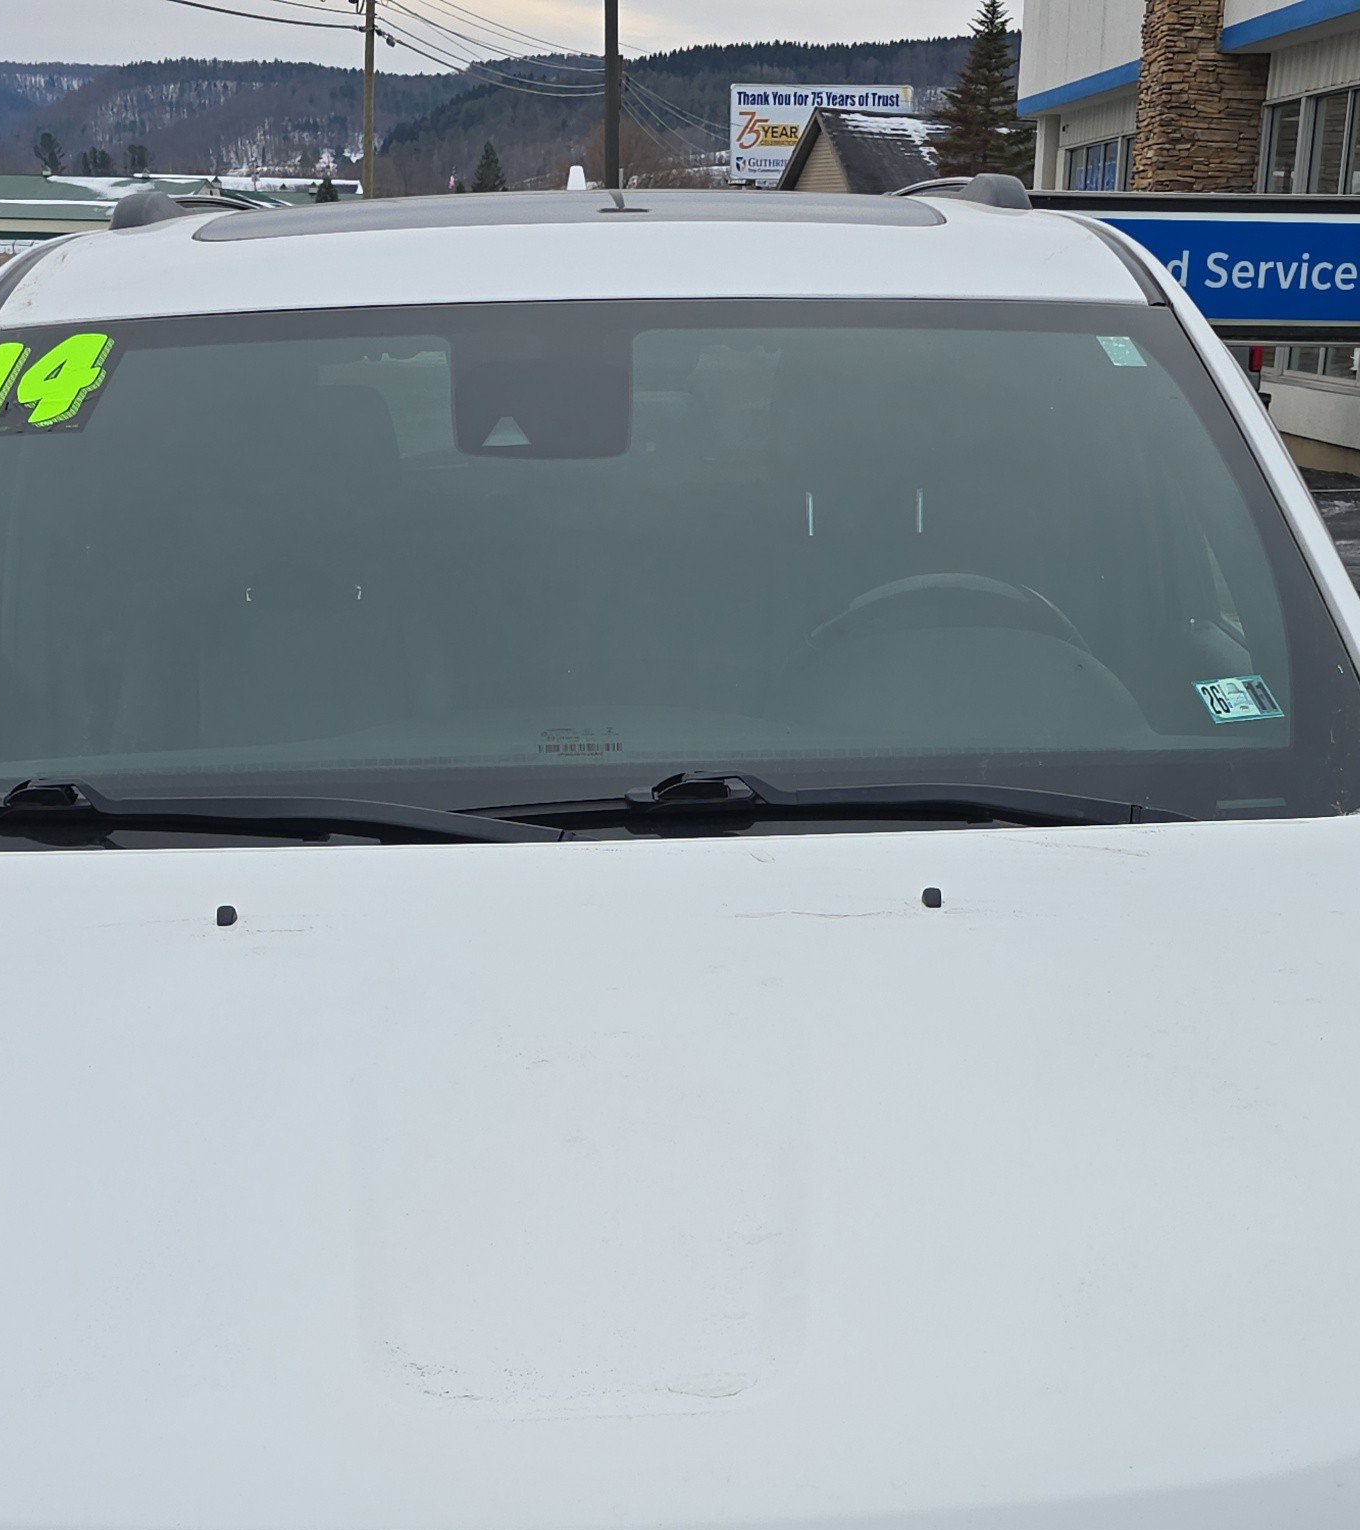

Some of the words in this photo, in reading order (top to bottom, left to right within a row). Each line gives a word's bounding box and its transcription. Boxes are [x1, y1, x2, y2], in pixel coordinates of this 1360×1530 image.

[736, 91, 770, 106] Thank
[771, 91, 791, 106] You
[793, 92, 809, 106] for
[811, 92, 824, 107] 75
[825, 92, 856, 107] Years
[858, 92, 870, 107] of
[871, 92, 900, 107] Trust
[736, 111, 770, 150] 75
[761, 125, 799, 139] YEAR
[1203, 251, 1359, 291] Service
[1200, 685, 1231, 715] 26
